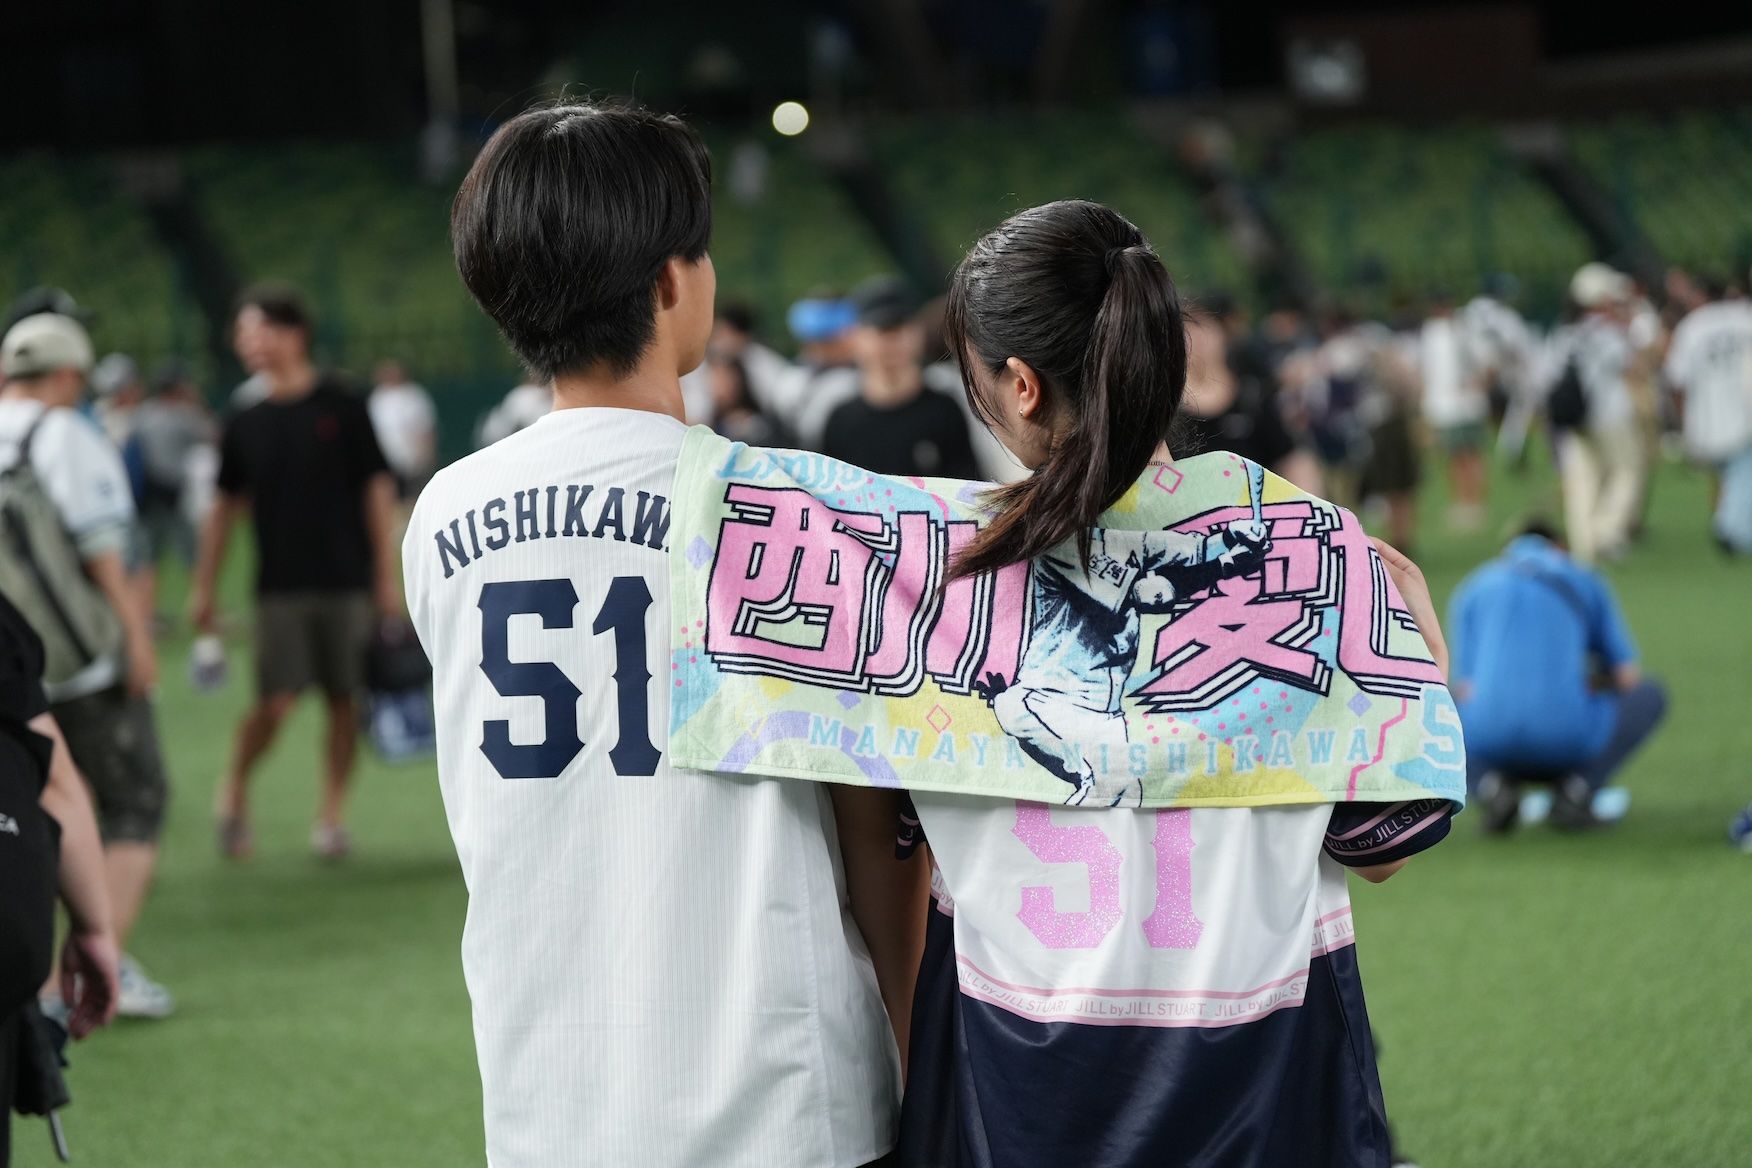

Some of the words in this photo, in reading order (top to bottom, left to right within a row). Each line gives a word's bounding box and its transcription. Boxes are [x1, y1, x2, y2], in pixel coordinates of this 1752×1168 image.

[434, 484, 670, 579] NISHIKAW
[477, 575, 662, 779] 51
[809, 713, 1026, 769] MANAYA
[1061, 727, 1371, 777] NISHIKAWA
[1009, 800, 1206, 948] 51
[1357, 836, 1374, 849] by
[1375, 824, 1404, 844] JILL
[980, 983, 998, 995] by
[995, 992, 1024, 1009] JILL
[1026, 1000, 1069, 1013] STUART
[1076, 999, 1107, 1014] JILL
[1110, 1002, 1125, 1017] by
[1125, 1001, 1155, 1015] JILL
[1157, 1002, 1207, 1017] STUART
[1214, 1002, 1247, 1017] JILL
[1249, 999, 1263, 1011] by
